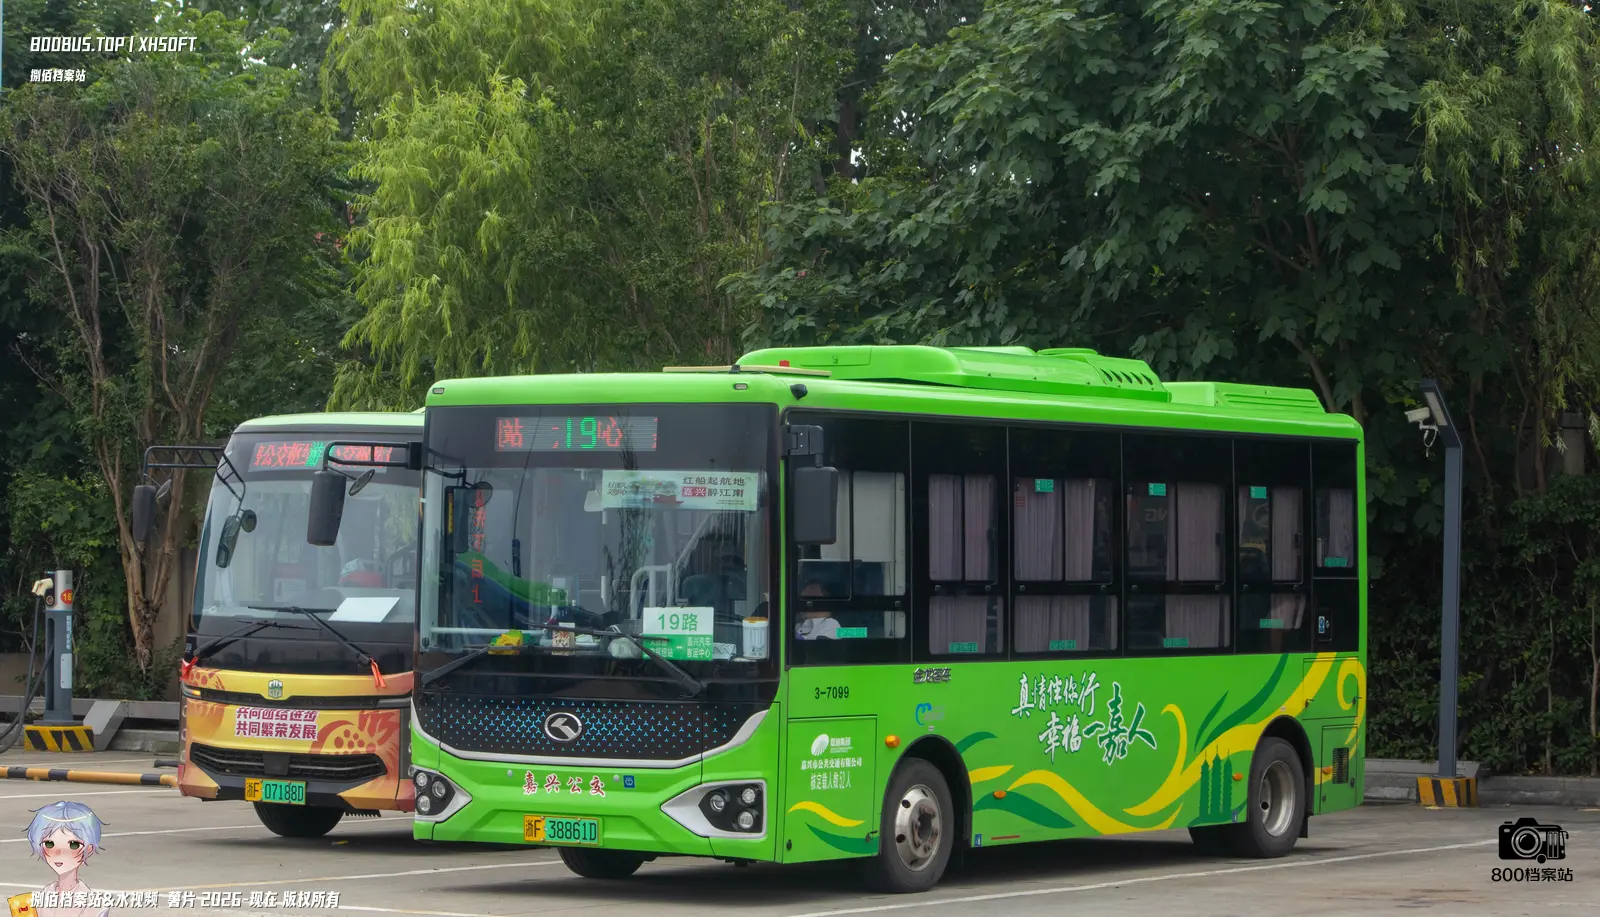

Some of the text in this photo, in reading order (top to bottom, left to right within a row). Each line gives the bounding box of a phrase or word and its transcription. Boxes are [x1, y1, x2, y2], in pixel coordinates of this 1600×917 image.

[566, 416, 597, 449] 19
[682, 476, 745, 487] 红船起航地
[658, 613, 698, 632] 19路
[814, 686, 850, 699] 3-7099
[236, 721, 317, 739] 共同繁荣发展
[264, 783, 304, 802] 07188D
[523, 771, 605, 797] 嘉兴公交
[548, 820, 597, 841] 38861D
